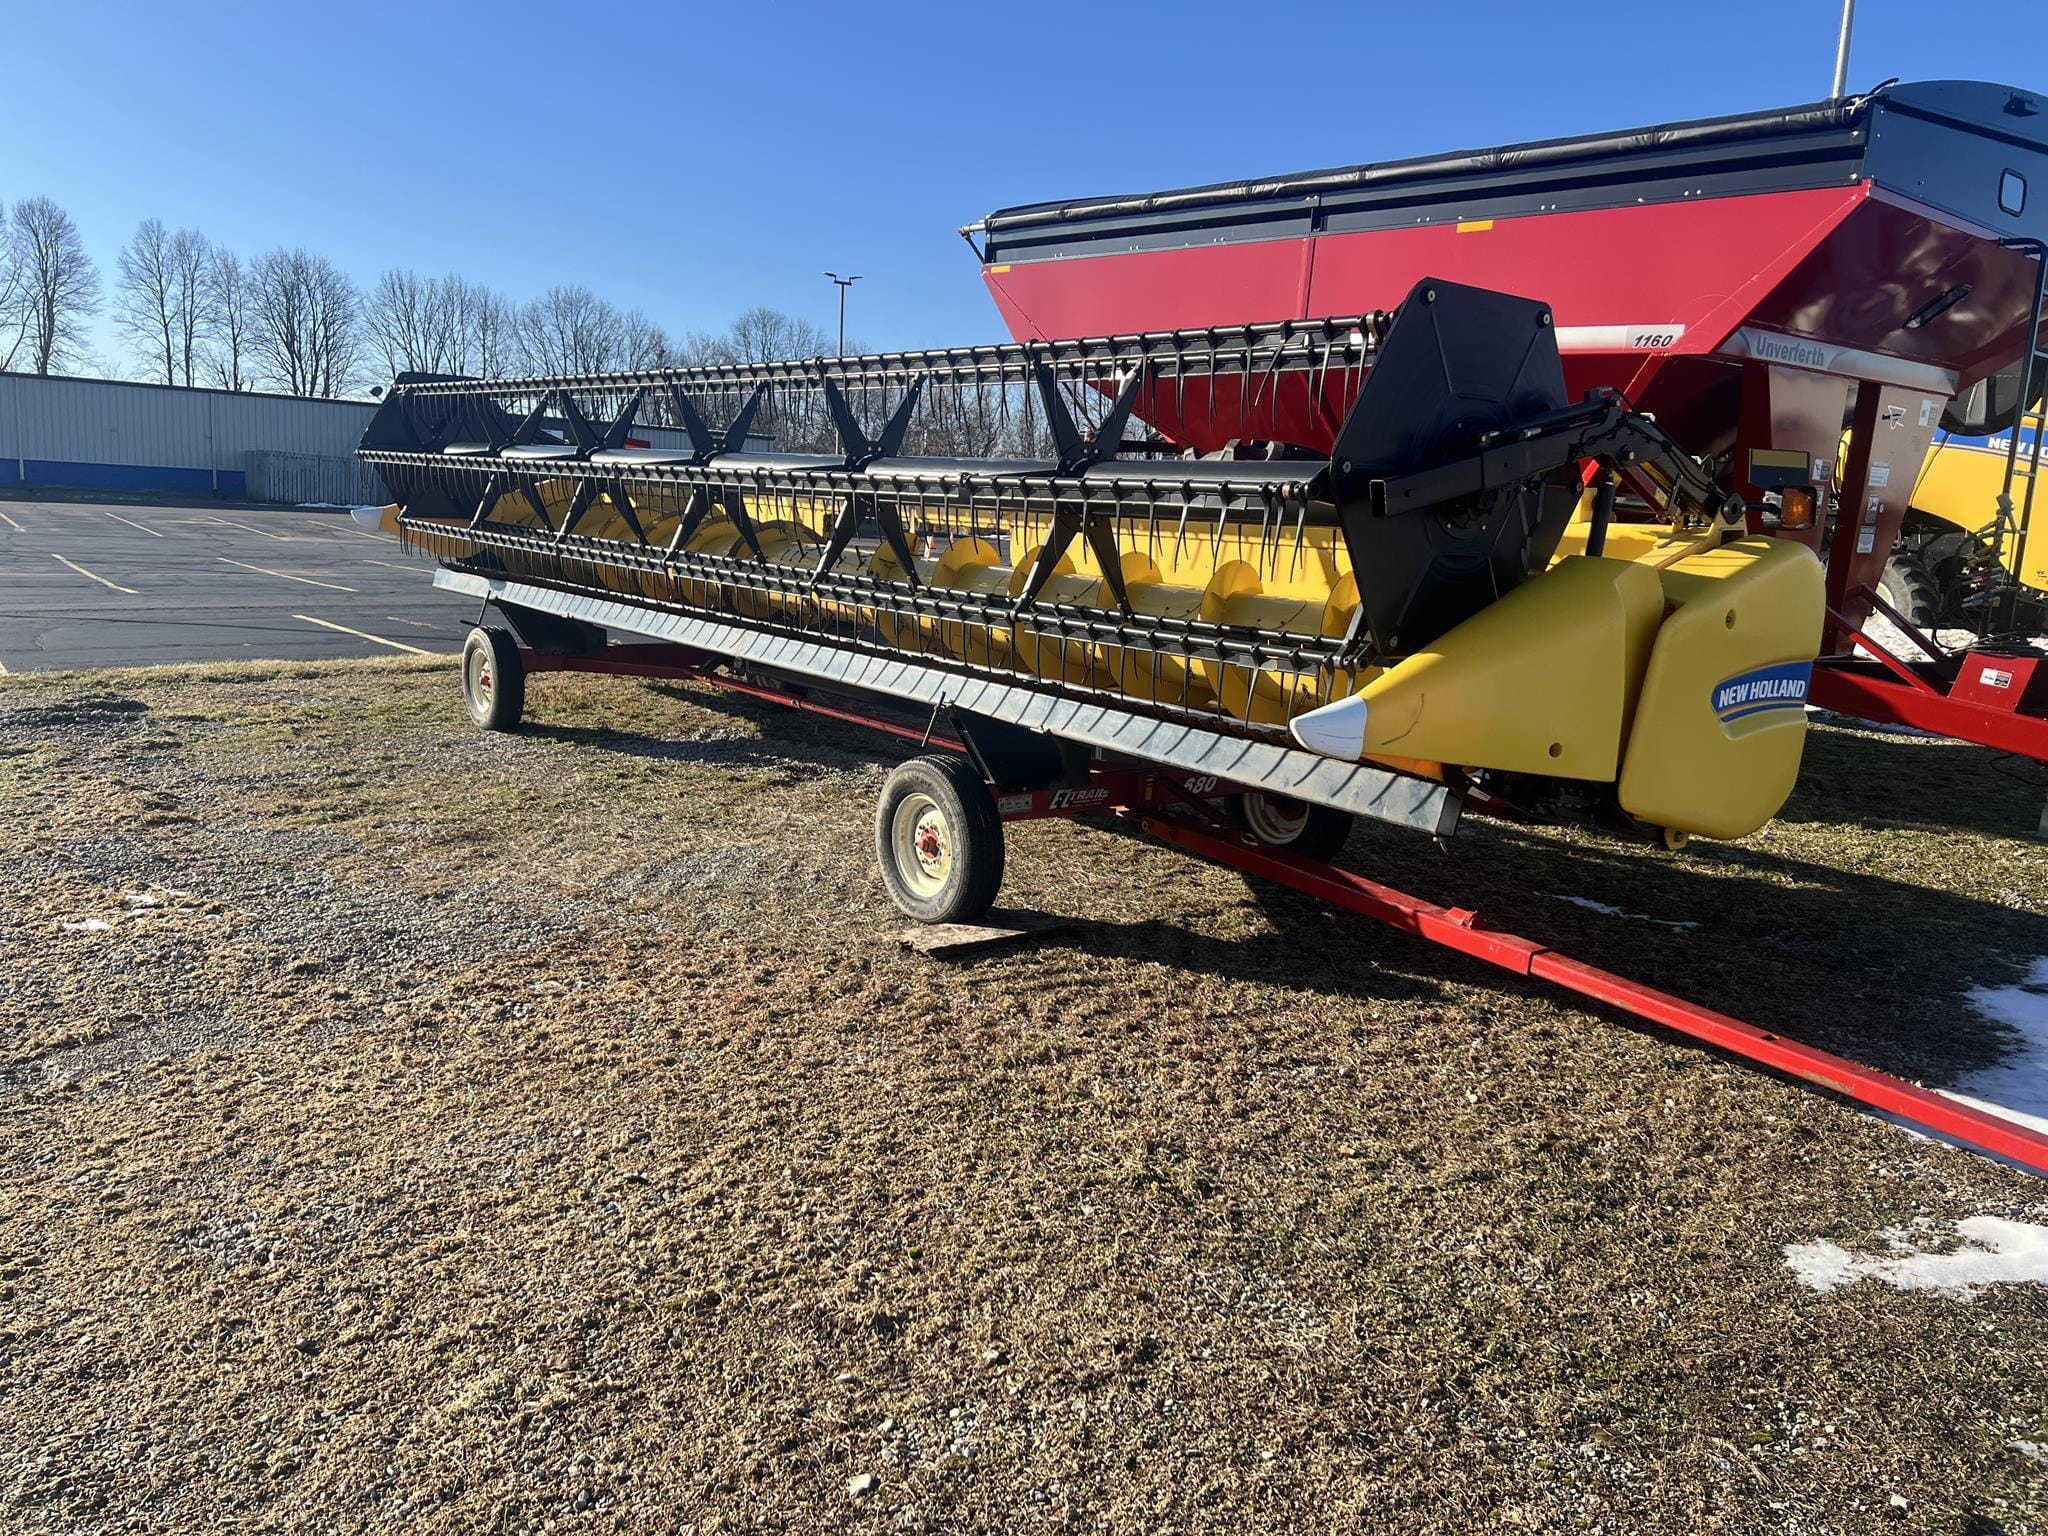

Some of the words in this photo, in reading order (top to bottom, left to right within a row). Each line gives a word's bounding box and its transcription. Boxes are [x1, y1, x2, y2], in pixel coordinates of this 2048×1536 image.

[1633, 335, 1674, 348] 1160
[1756, 336, 1825, 367] Unverferth
[1719, 683, 1750, 708] NEW
[1749, 680, 1806, 700] HOLLAND
